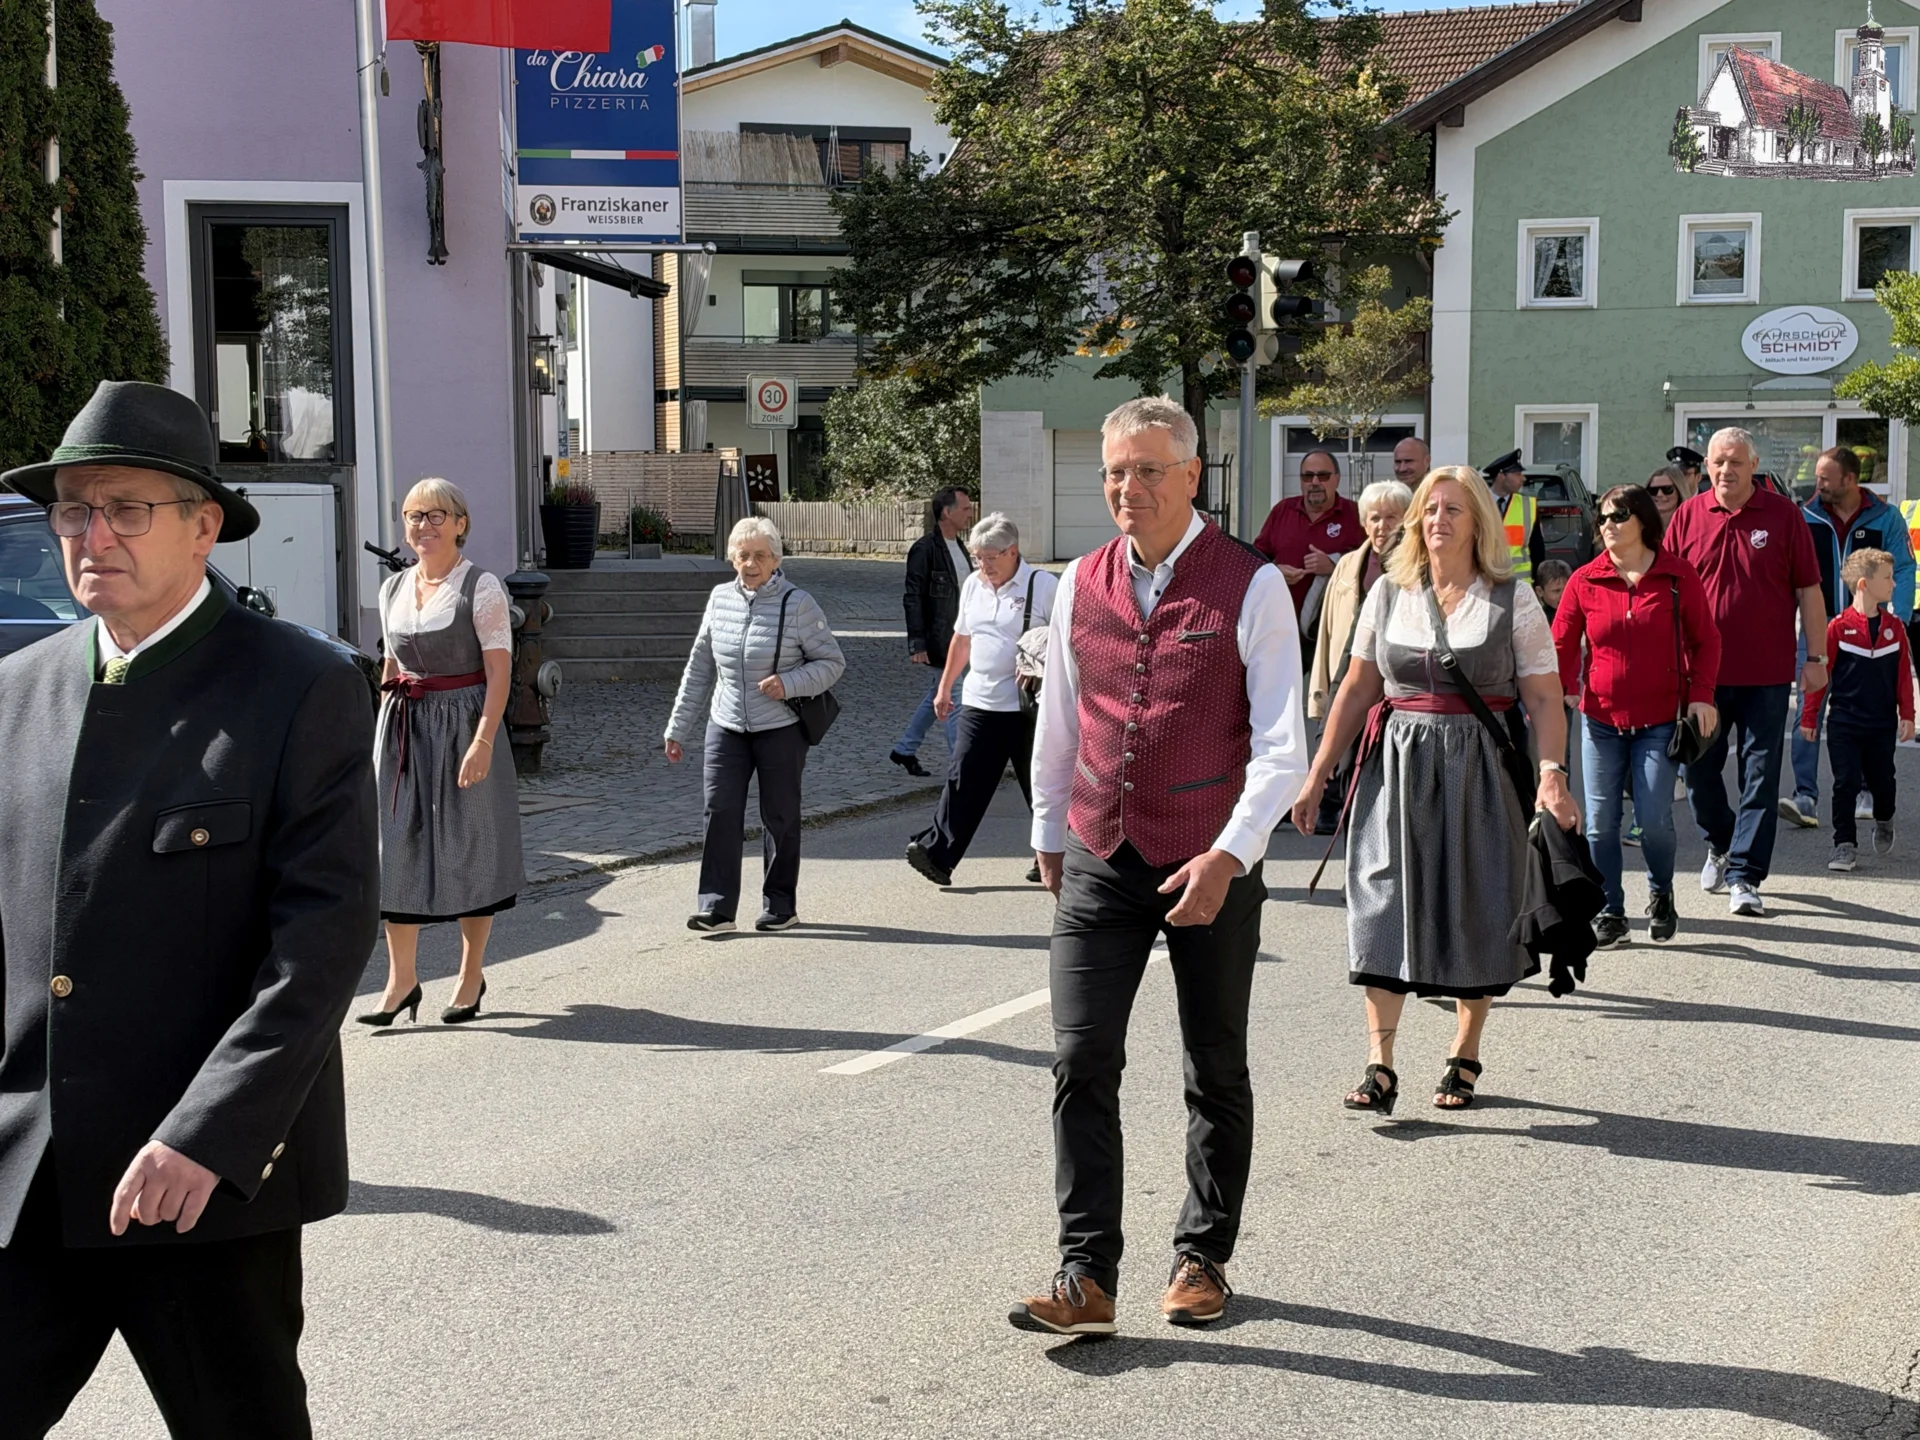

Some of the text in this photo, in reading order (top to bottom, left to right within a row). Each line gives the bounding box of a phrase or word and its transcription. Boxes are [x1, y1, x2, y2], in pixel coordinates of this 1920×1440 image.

[526, 49, 649, 92] da Chiara
[550, 97, 650, 111] PIZZERIA
[561, 196, 669, 213] Franziskaner
[587, 214, 644, 225] WEISSBIER
[1754, 330, 1848, 341] FAHRSCHULE
[1760, 341, 1842, 353] SCHMIDT
[764, 389, 782, 404] 30
[761, 414, 784, 422] ZONE
